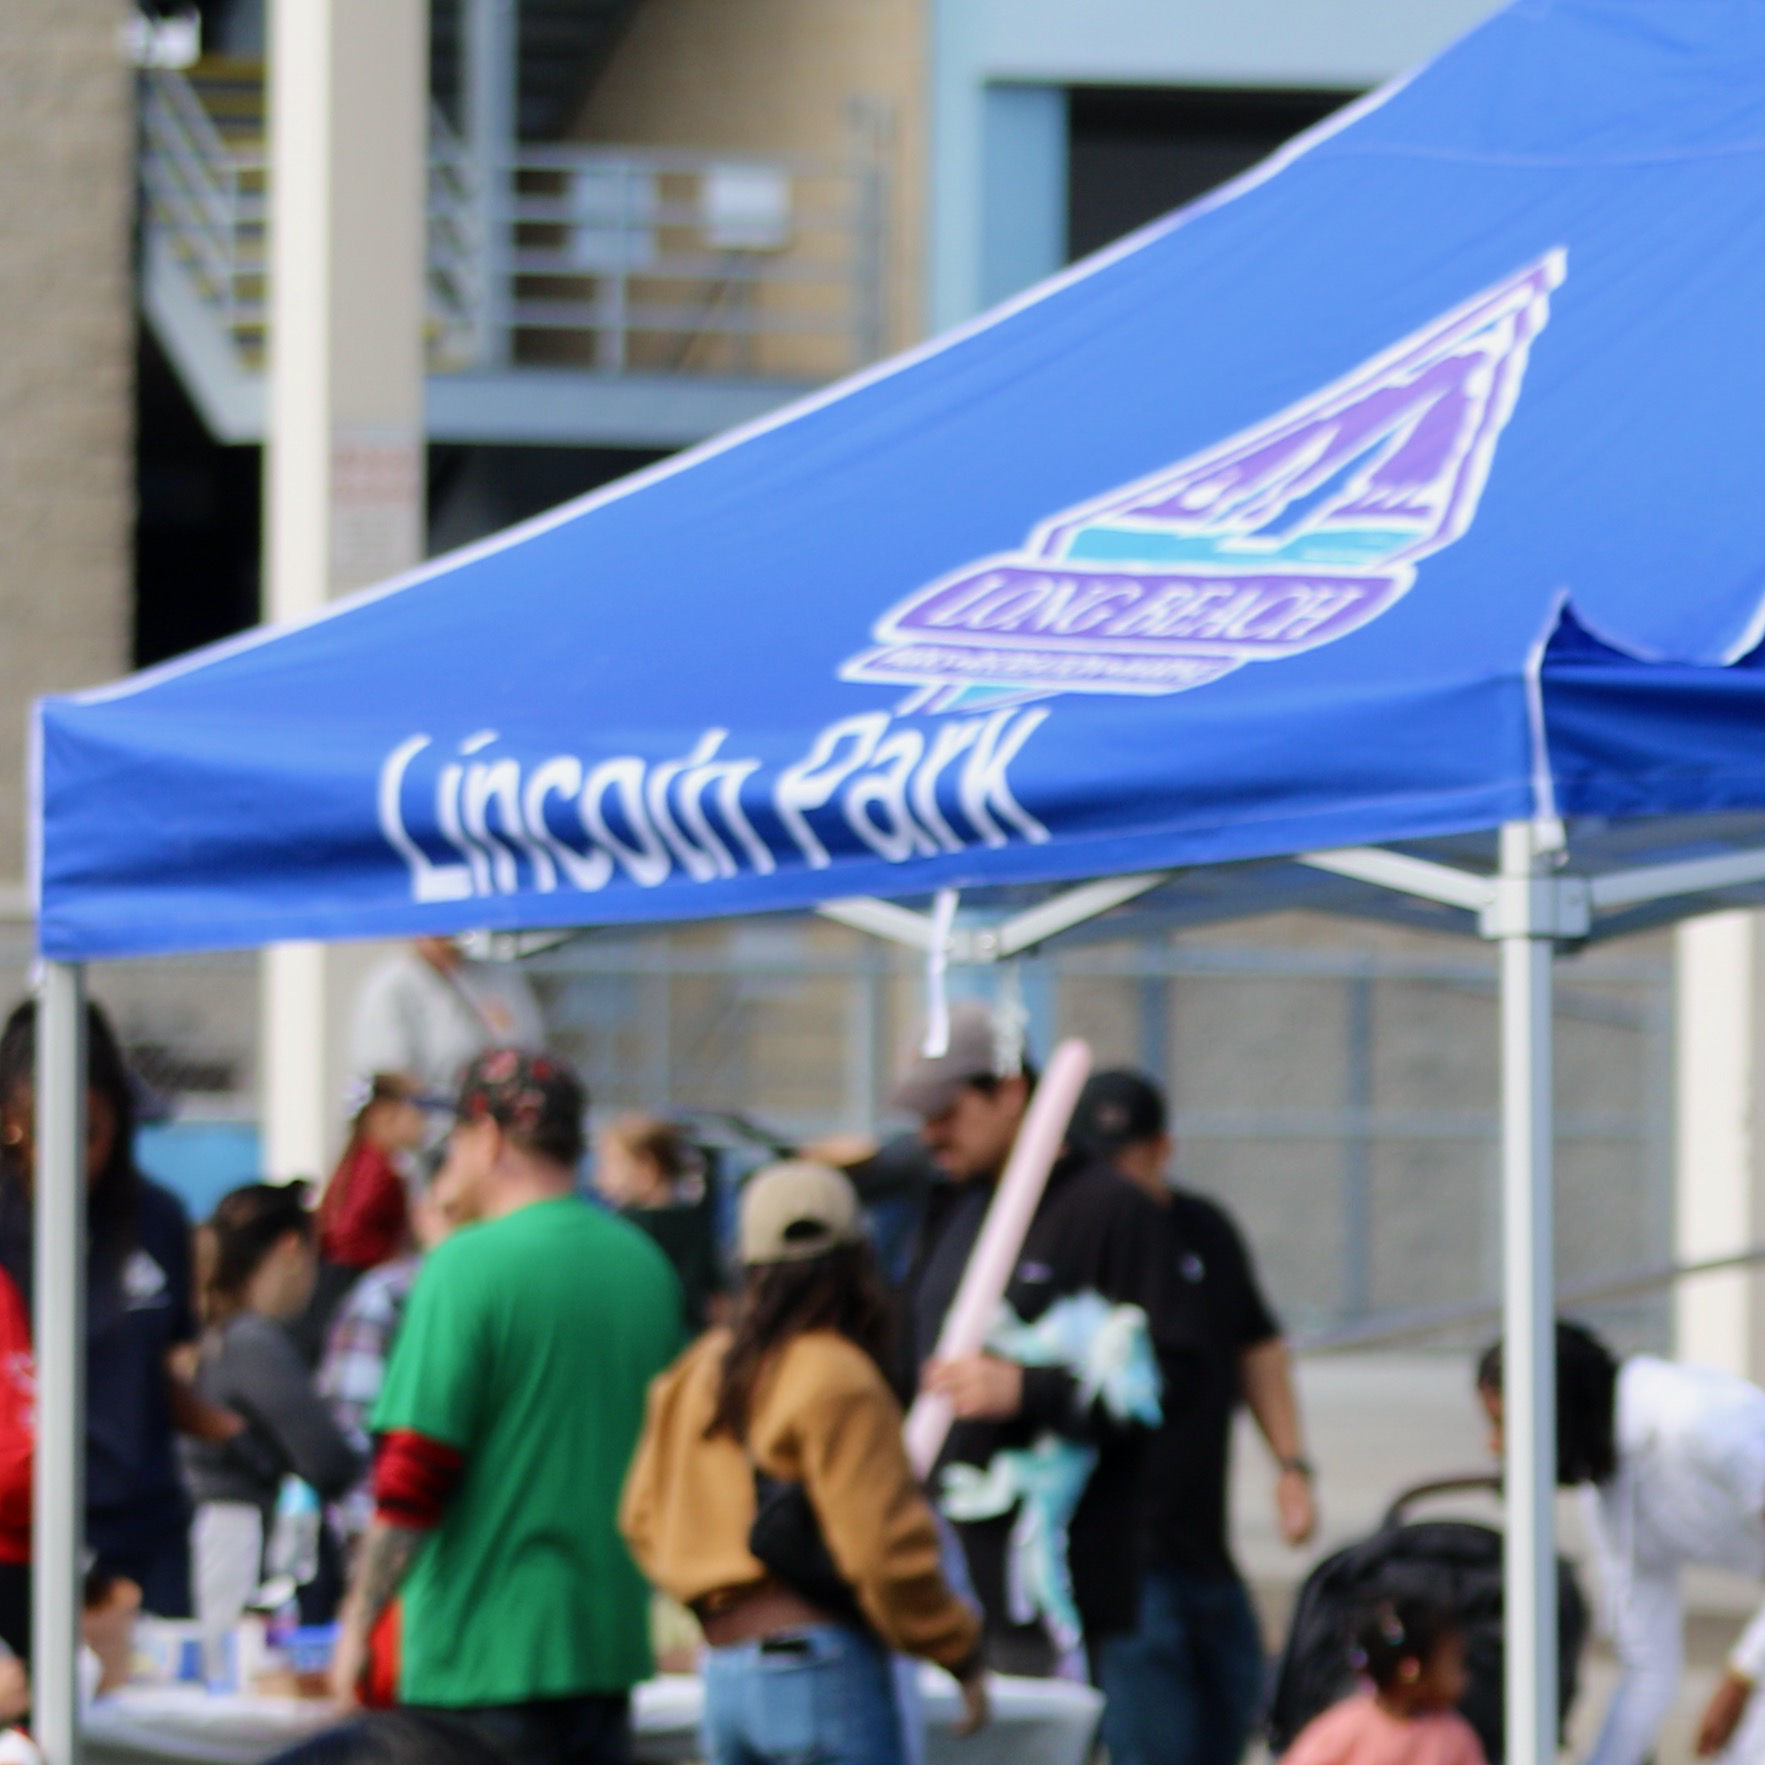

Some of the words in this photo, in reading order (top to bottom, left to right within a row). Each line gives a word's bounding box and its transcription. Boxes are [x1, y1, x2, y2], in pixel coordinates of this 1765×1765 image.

[927, 573, 1143, 636] LONG
[1106, 580, 1366, 641] BEACH
[775, 706, 1052, 871] Park
